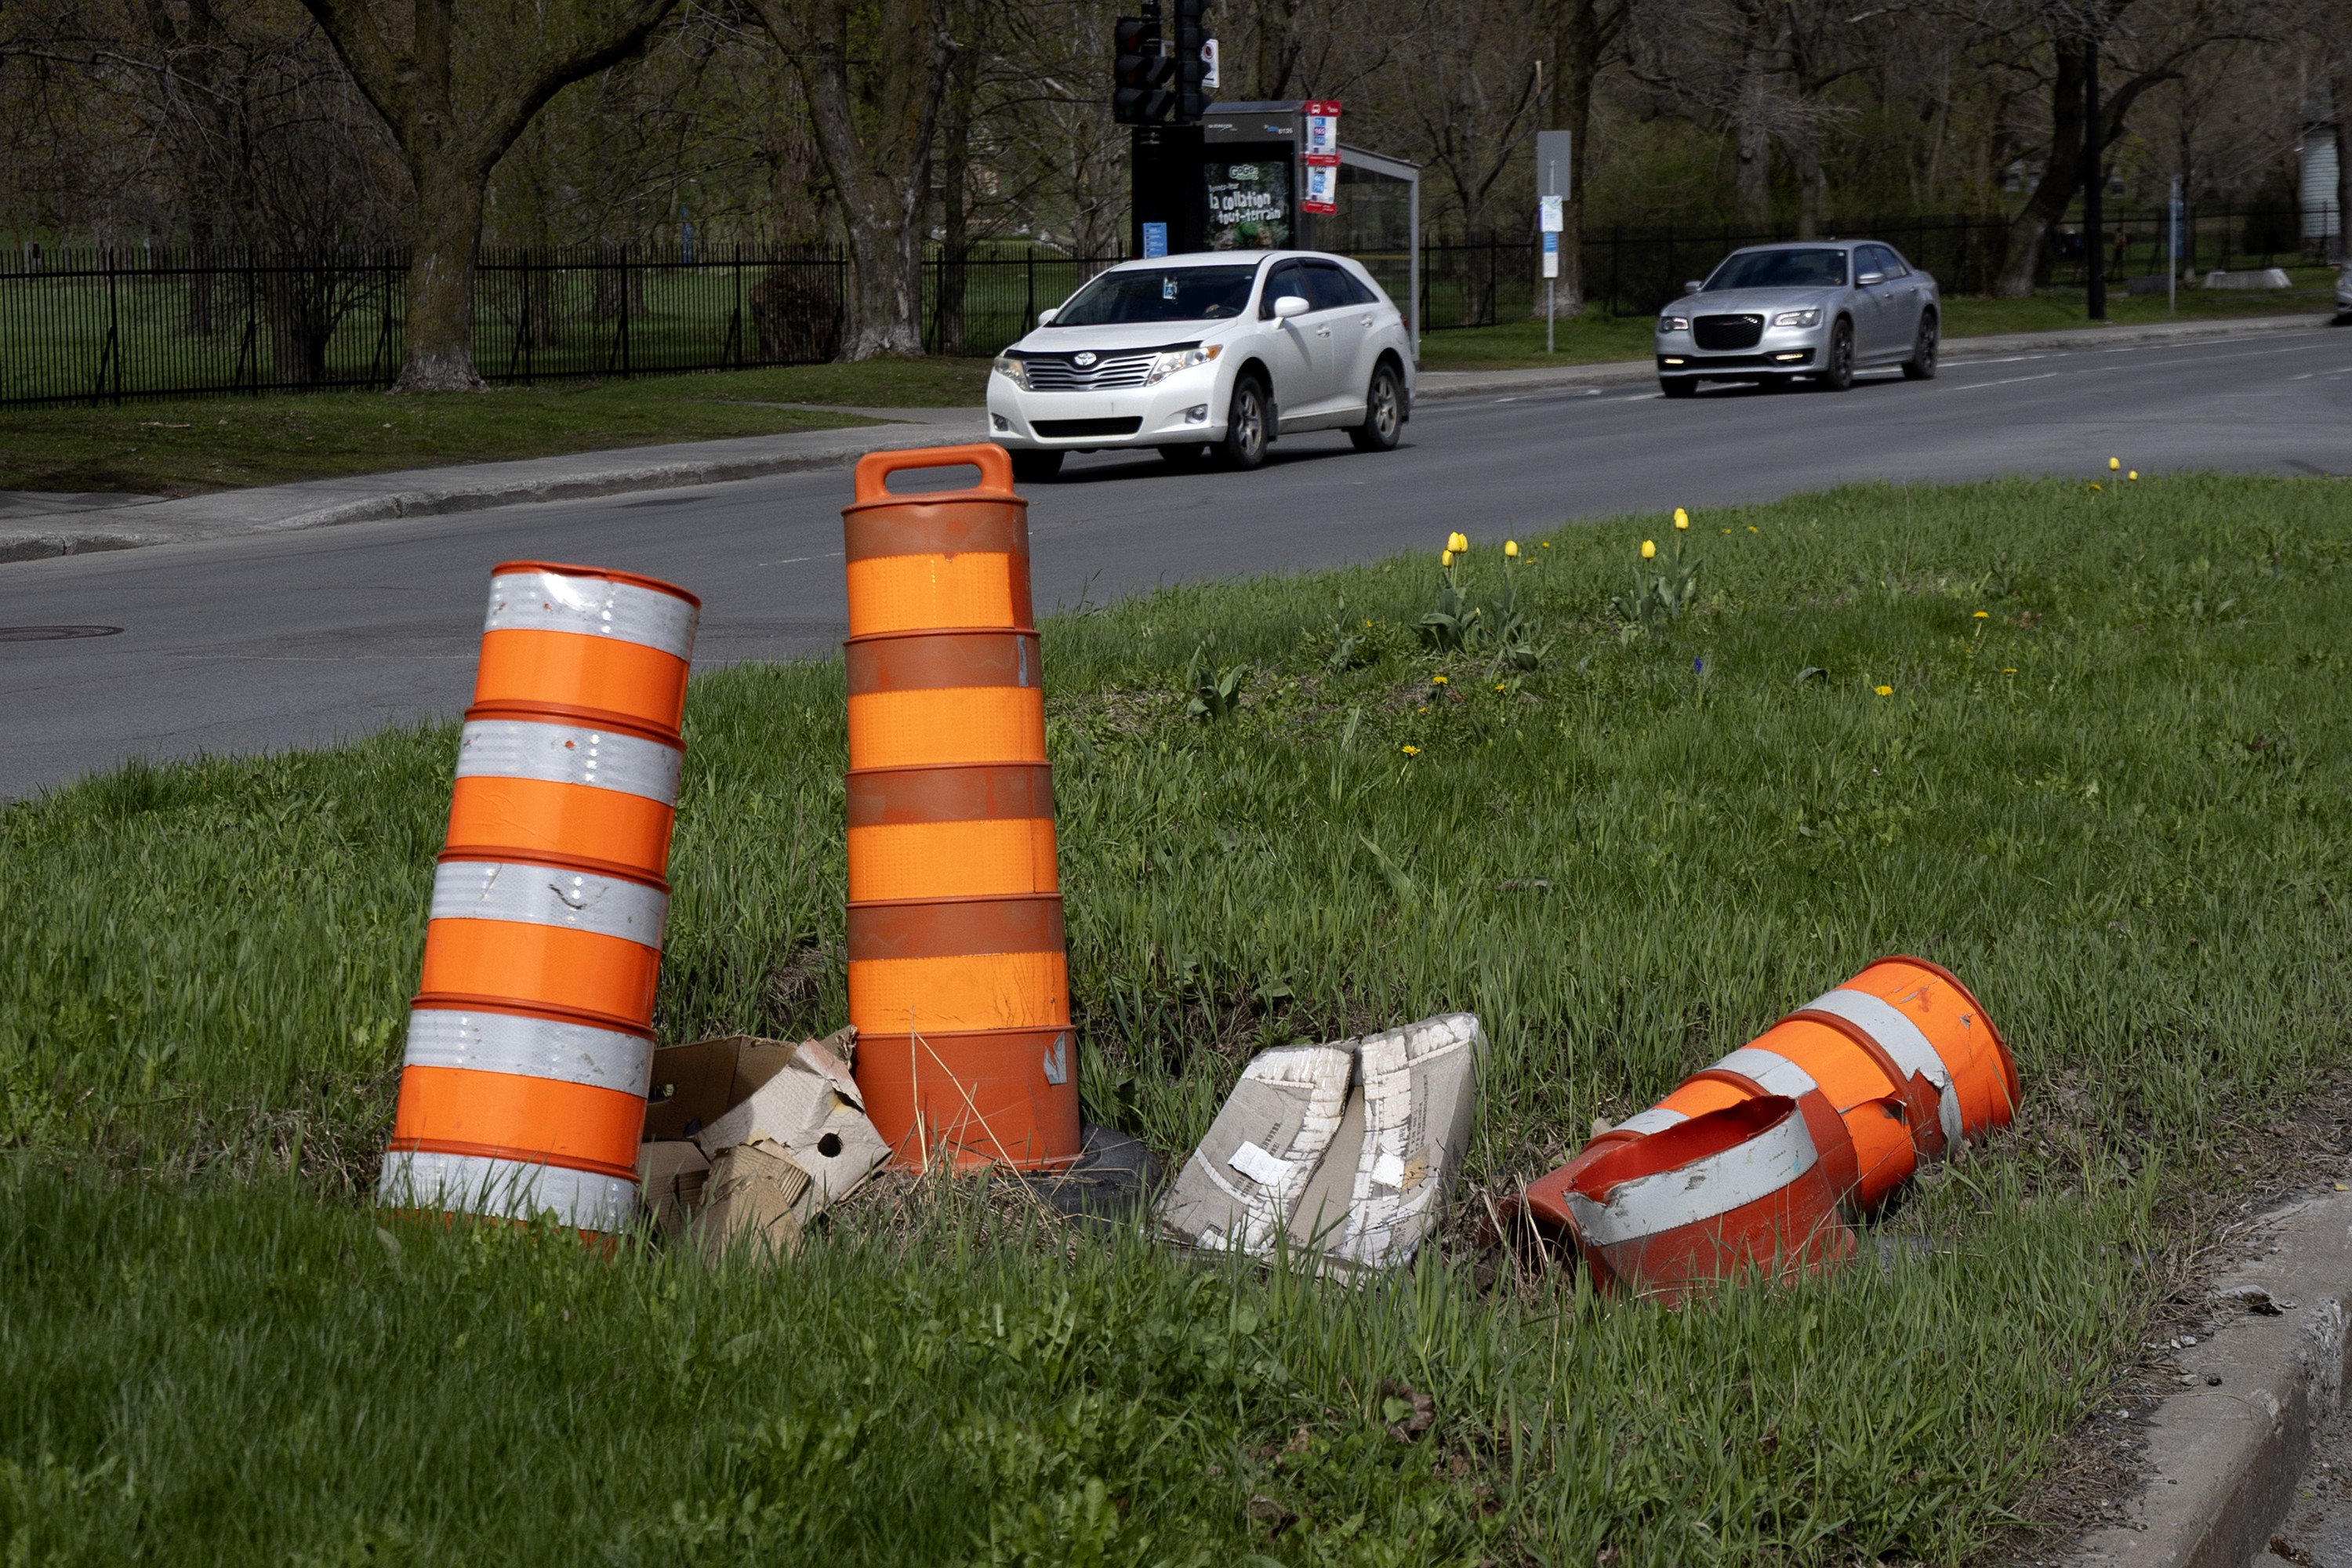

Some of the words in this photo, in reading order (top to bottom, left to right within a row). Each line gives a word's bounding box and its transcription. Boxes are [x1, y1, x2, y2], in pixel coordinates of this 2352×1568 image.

[1209, 193, 1220, 209] la
[1222, 191, 1271, 211] collation
[1218, 207, 1282, 225] tout-terrain
